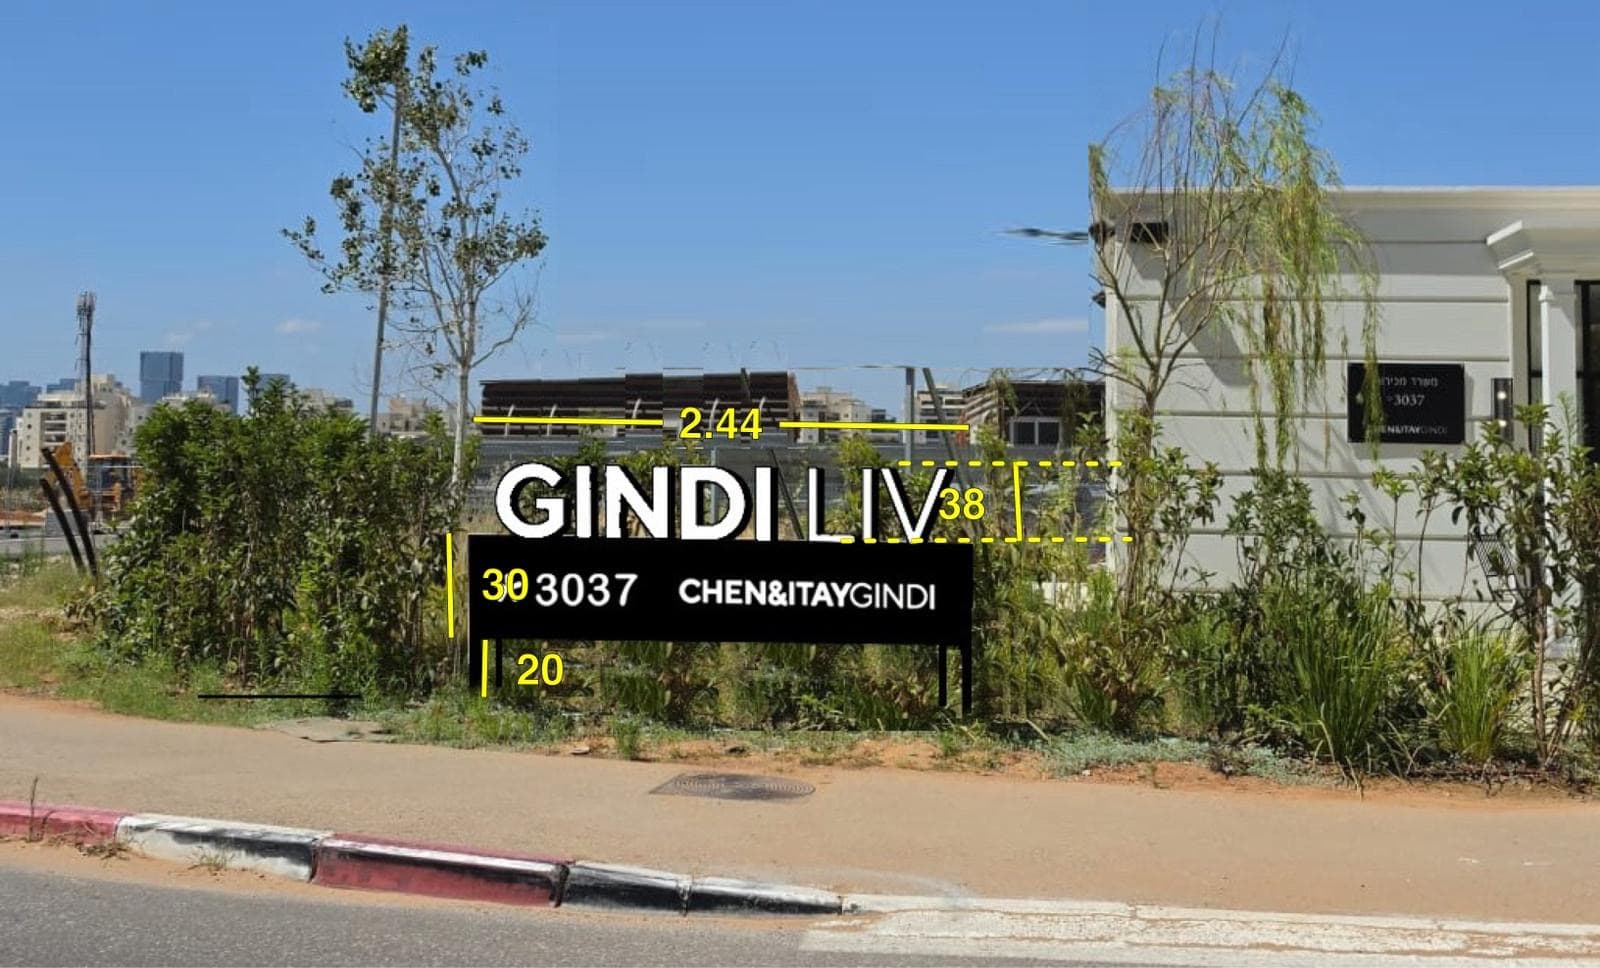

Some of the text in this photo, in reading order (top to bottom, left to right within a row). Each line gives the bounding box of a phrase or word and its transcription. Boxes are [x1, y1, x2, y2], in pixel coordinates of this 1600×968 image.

[495, 463, 947, 543] GINDI LIV
[679, 578, 936, 611] CHEN&ITAYGINDI
